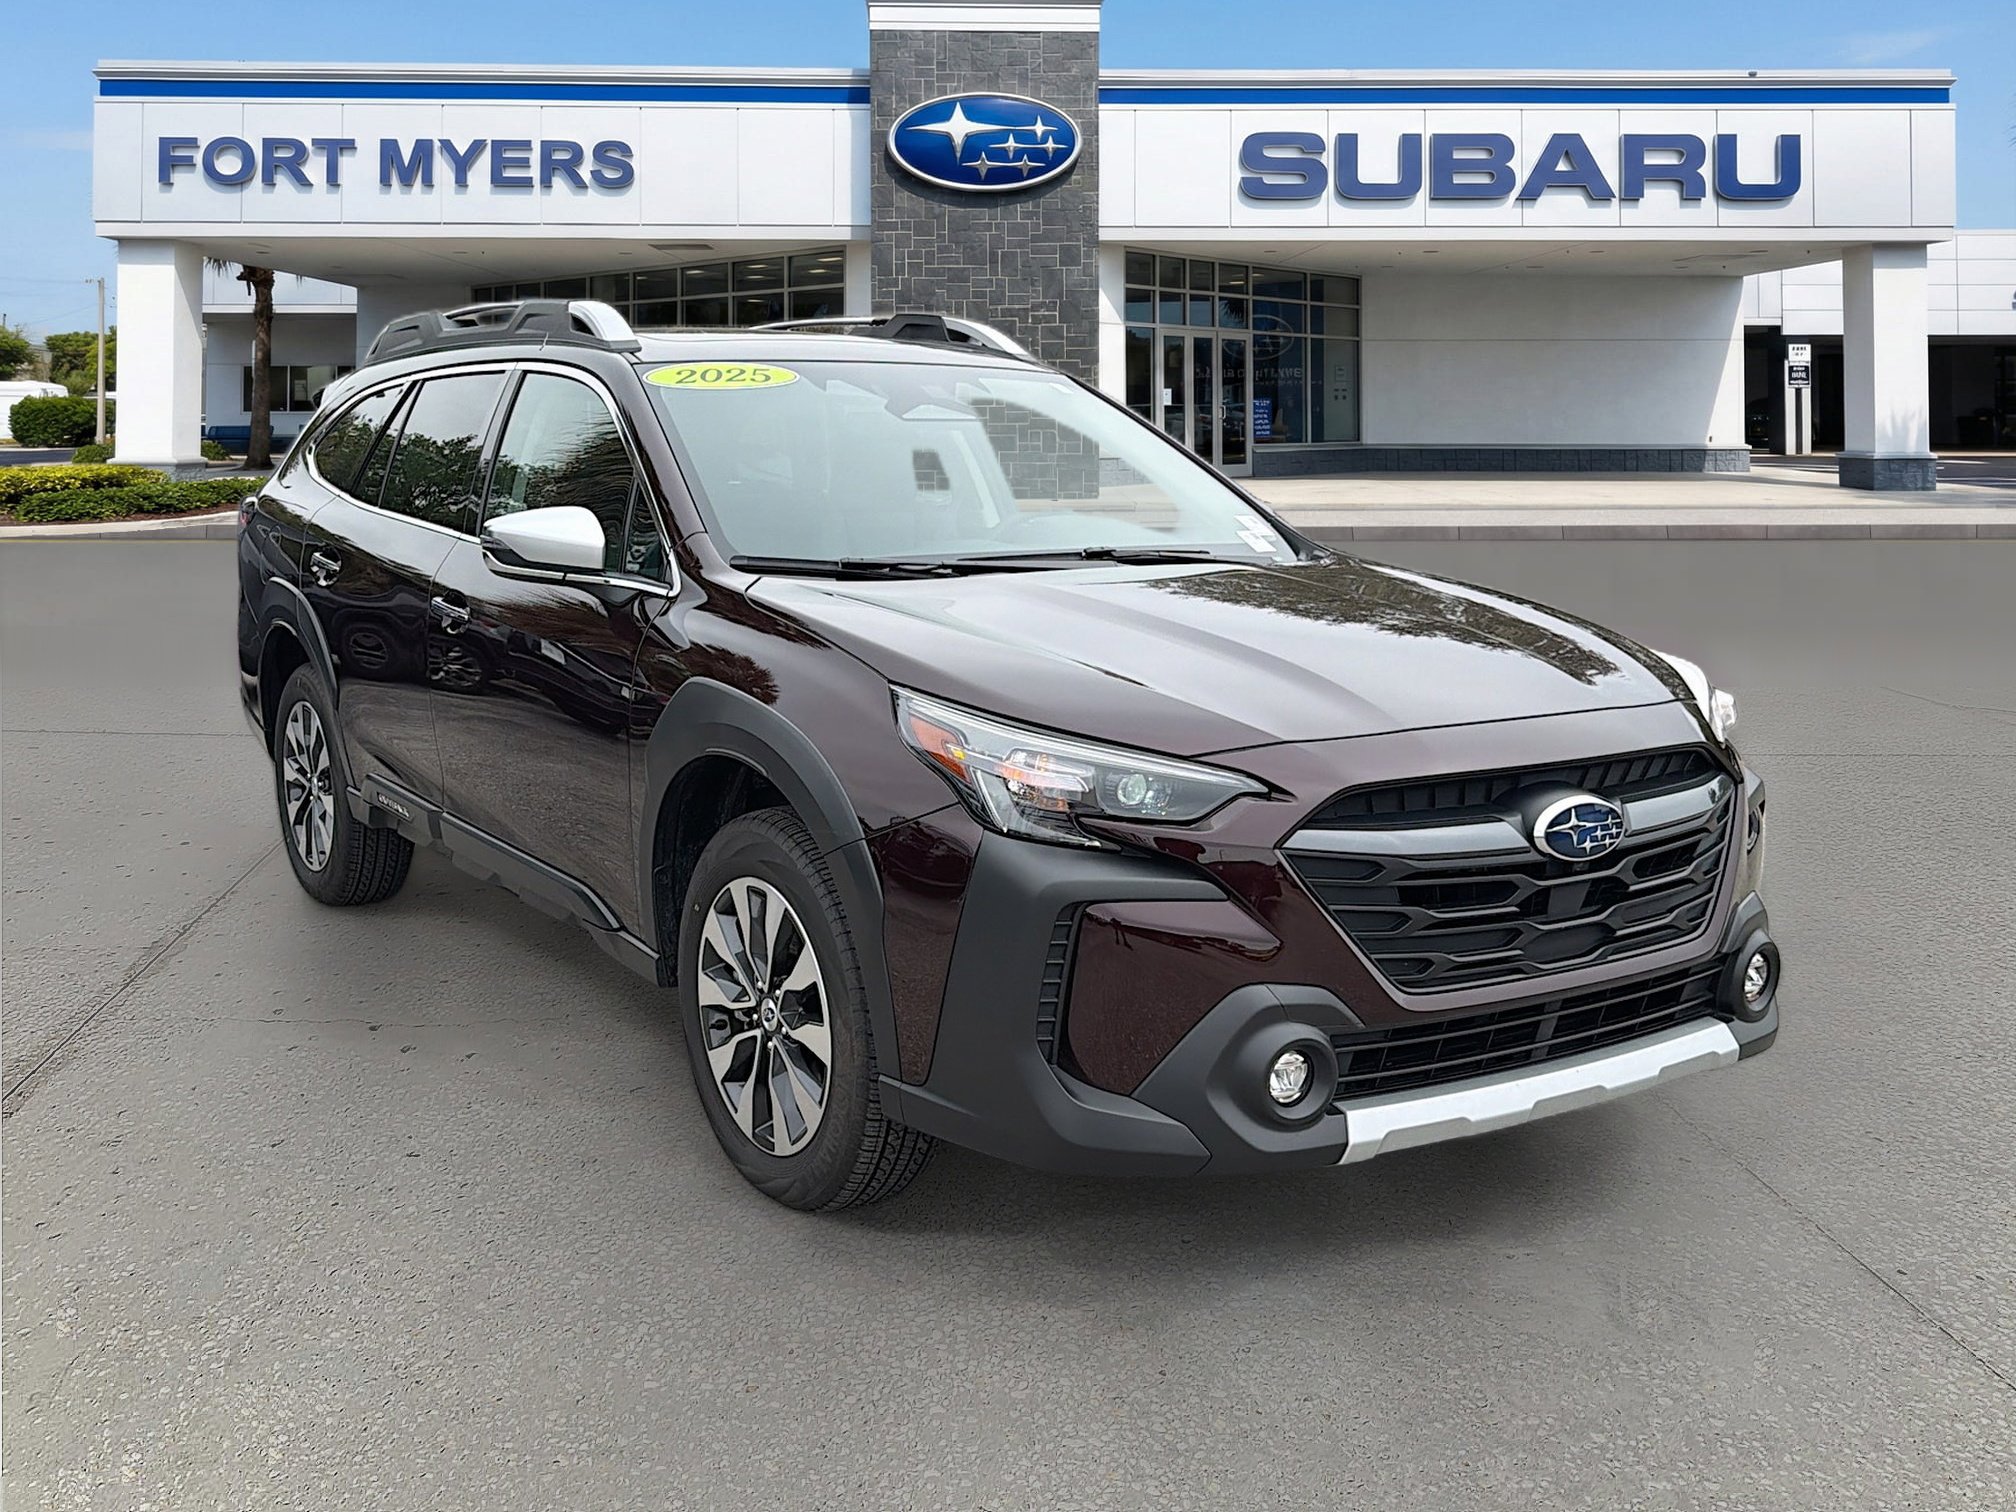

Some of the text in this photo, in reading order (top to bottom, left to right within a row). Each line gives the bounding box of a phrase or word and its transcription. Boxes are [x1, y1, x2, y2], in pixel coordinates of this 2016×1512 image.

[158, 136, 635, 189] FORT MYERS
[1239, 131, 1802, 202] SUBARU
[675, 368, 772, 384] 2025
